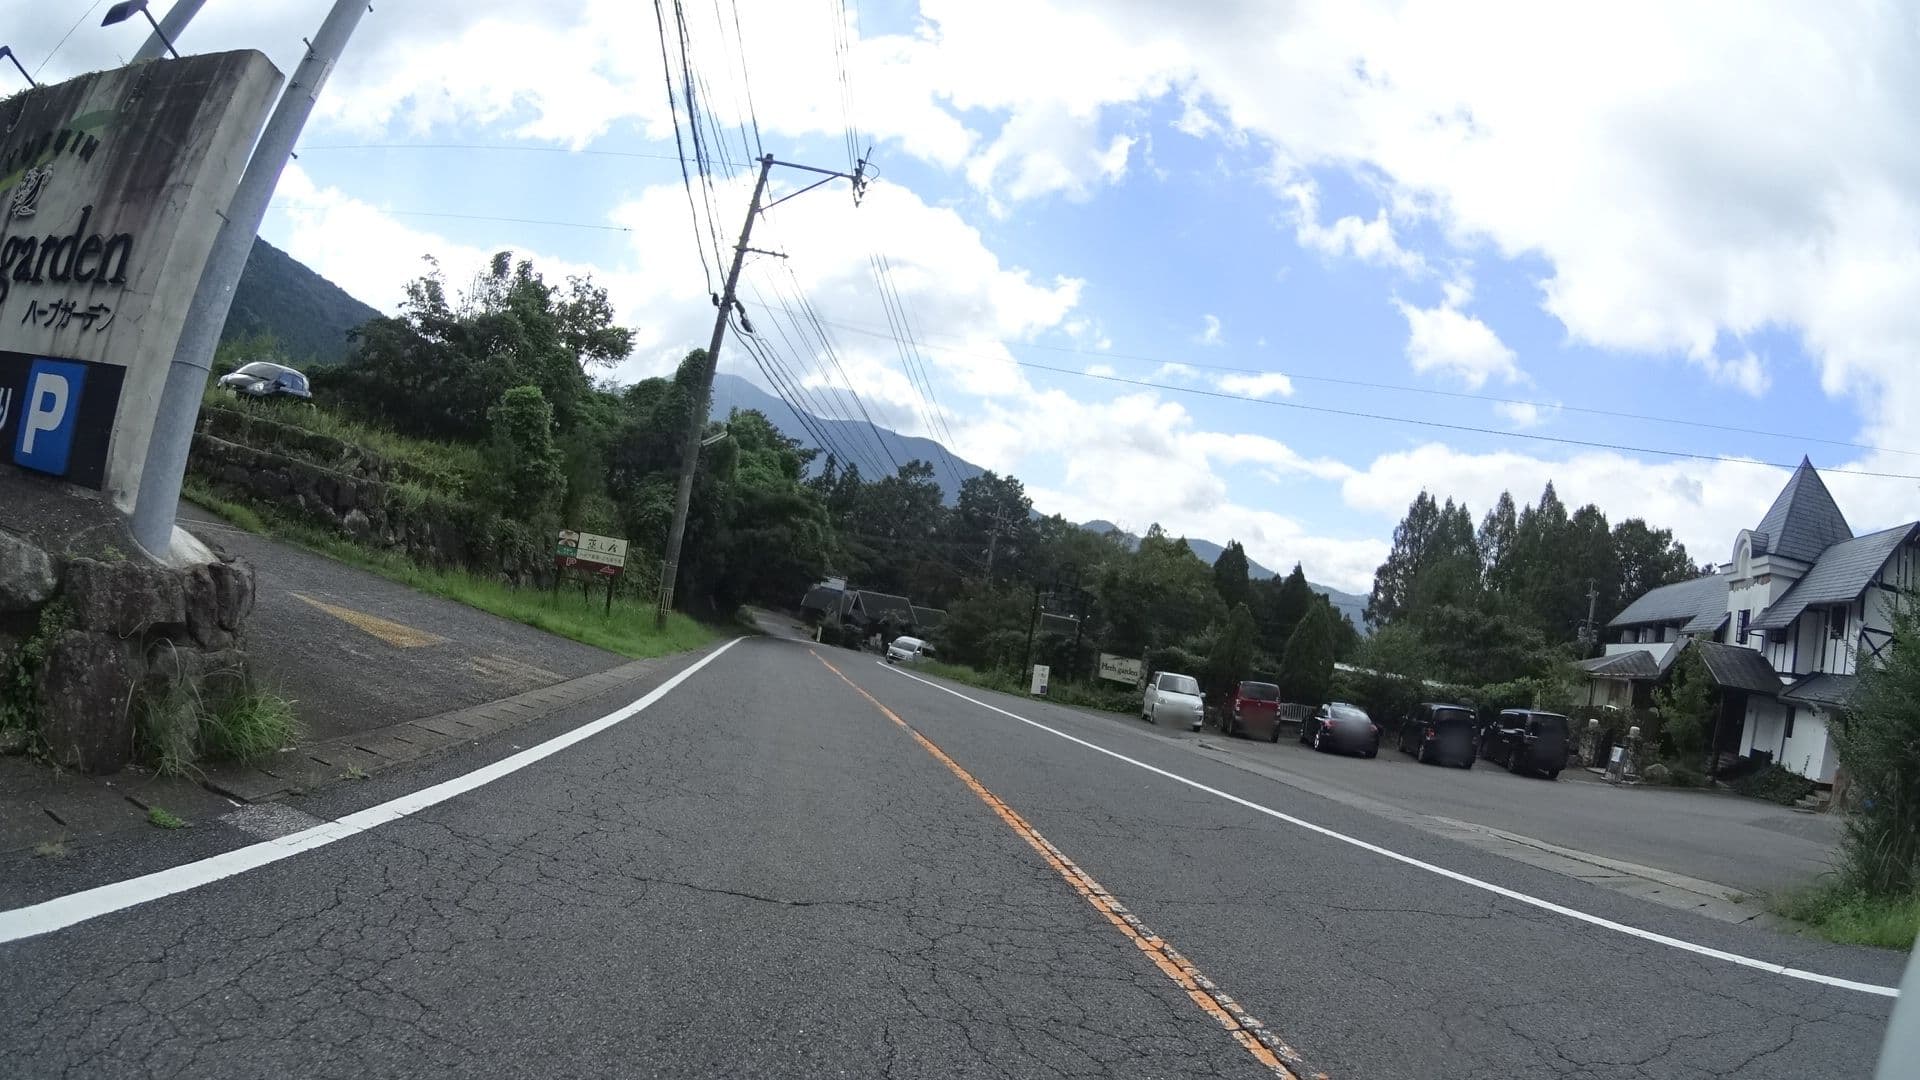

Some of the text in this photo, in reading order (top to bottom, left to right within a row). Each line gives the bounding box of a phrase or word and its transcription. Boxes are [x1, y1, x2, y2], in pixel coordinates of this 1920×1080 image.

[0, 204, 134, 304] garden
[21, 298, 115, 332] ハーブガーデン
[22, 371, 69, 454] P
